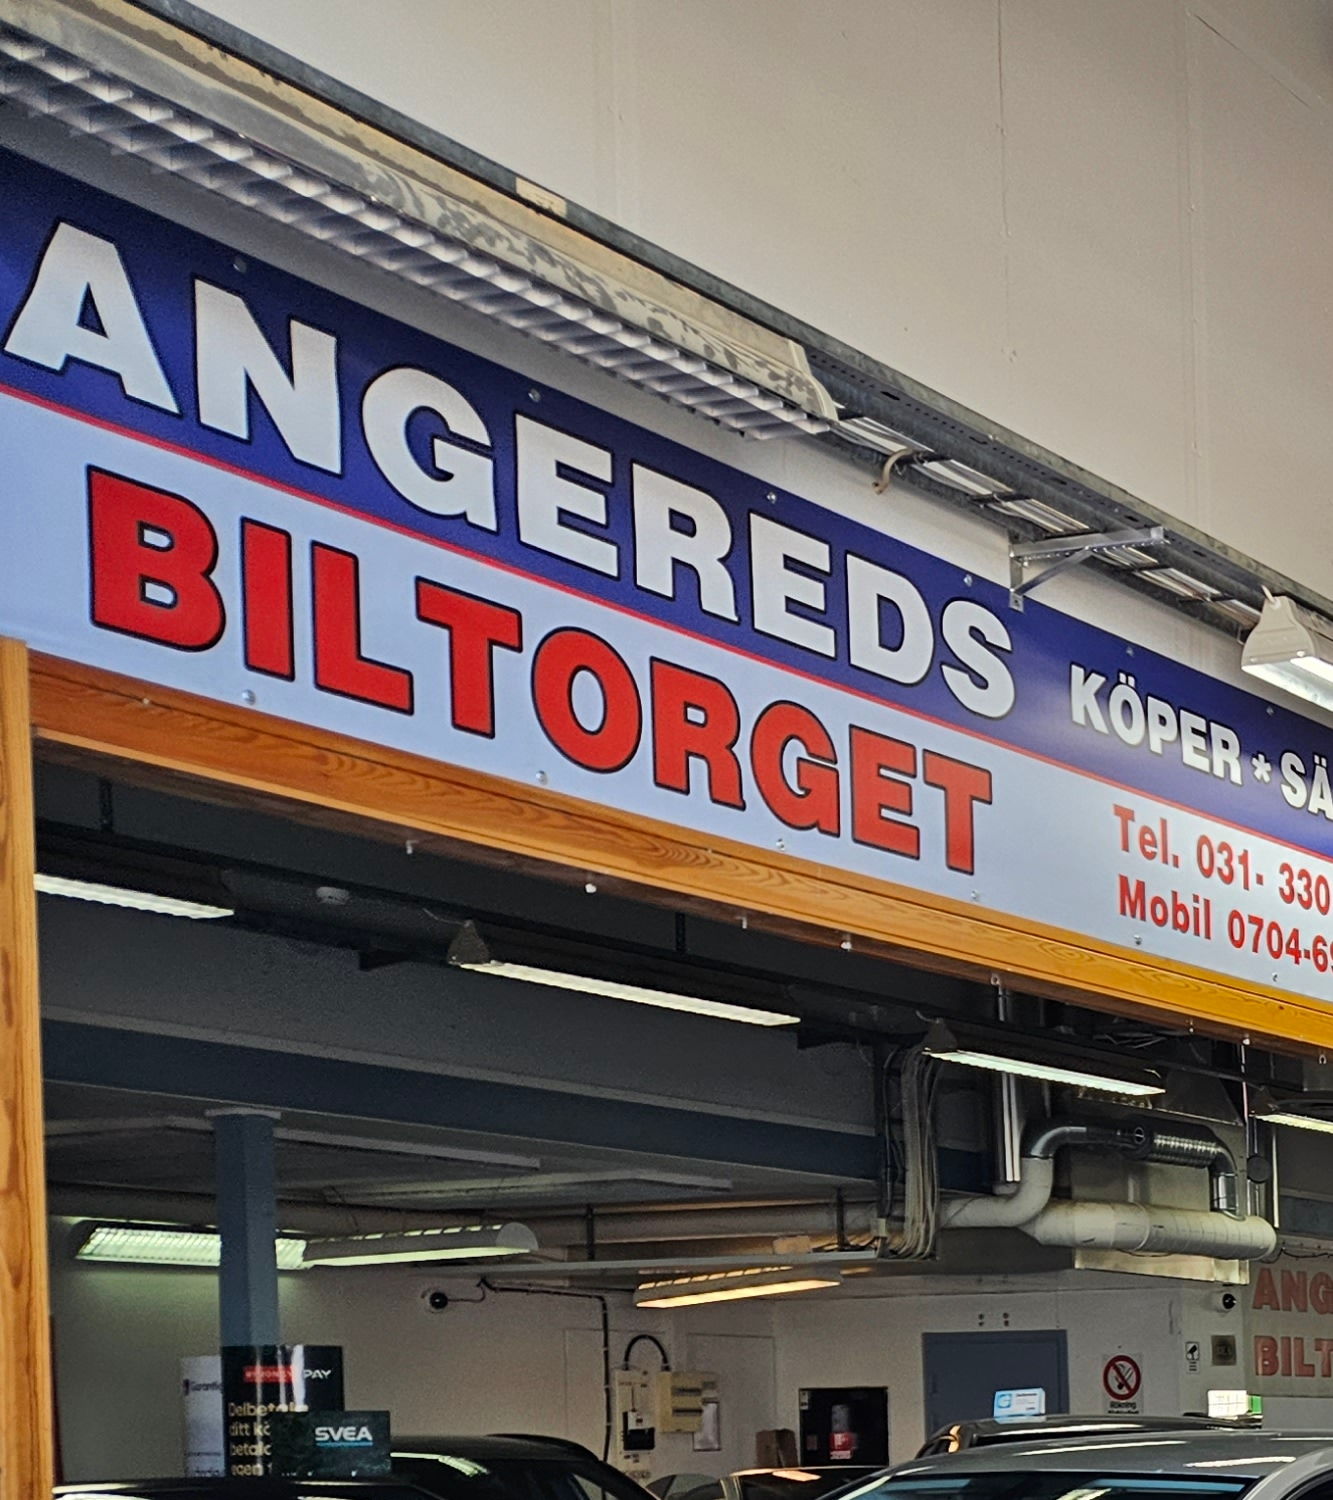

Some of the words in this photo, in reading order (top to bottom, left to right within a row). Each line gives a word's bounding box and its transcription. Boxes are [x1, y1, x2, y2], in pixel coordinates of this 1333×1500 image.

[3, 220, 1016, 719] ANGEREDS
[86, 464, 993, 875] BILTORGET
[1070, 662, 1243, 785] KÖPER
[1113, 803, 1181, 868] Tel.
[1279, 862, 1331, 916] 330
[1118, 874, 1212, 940] Mobil
[303, 1369, 332, 1379] PAY
[315, 1426, 373, 1442] SVEA
